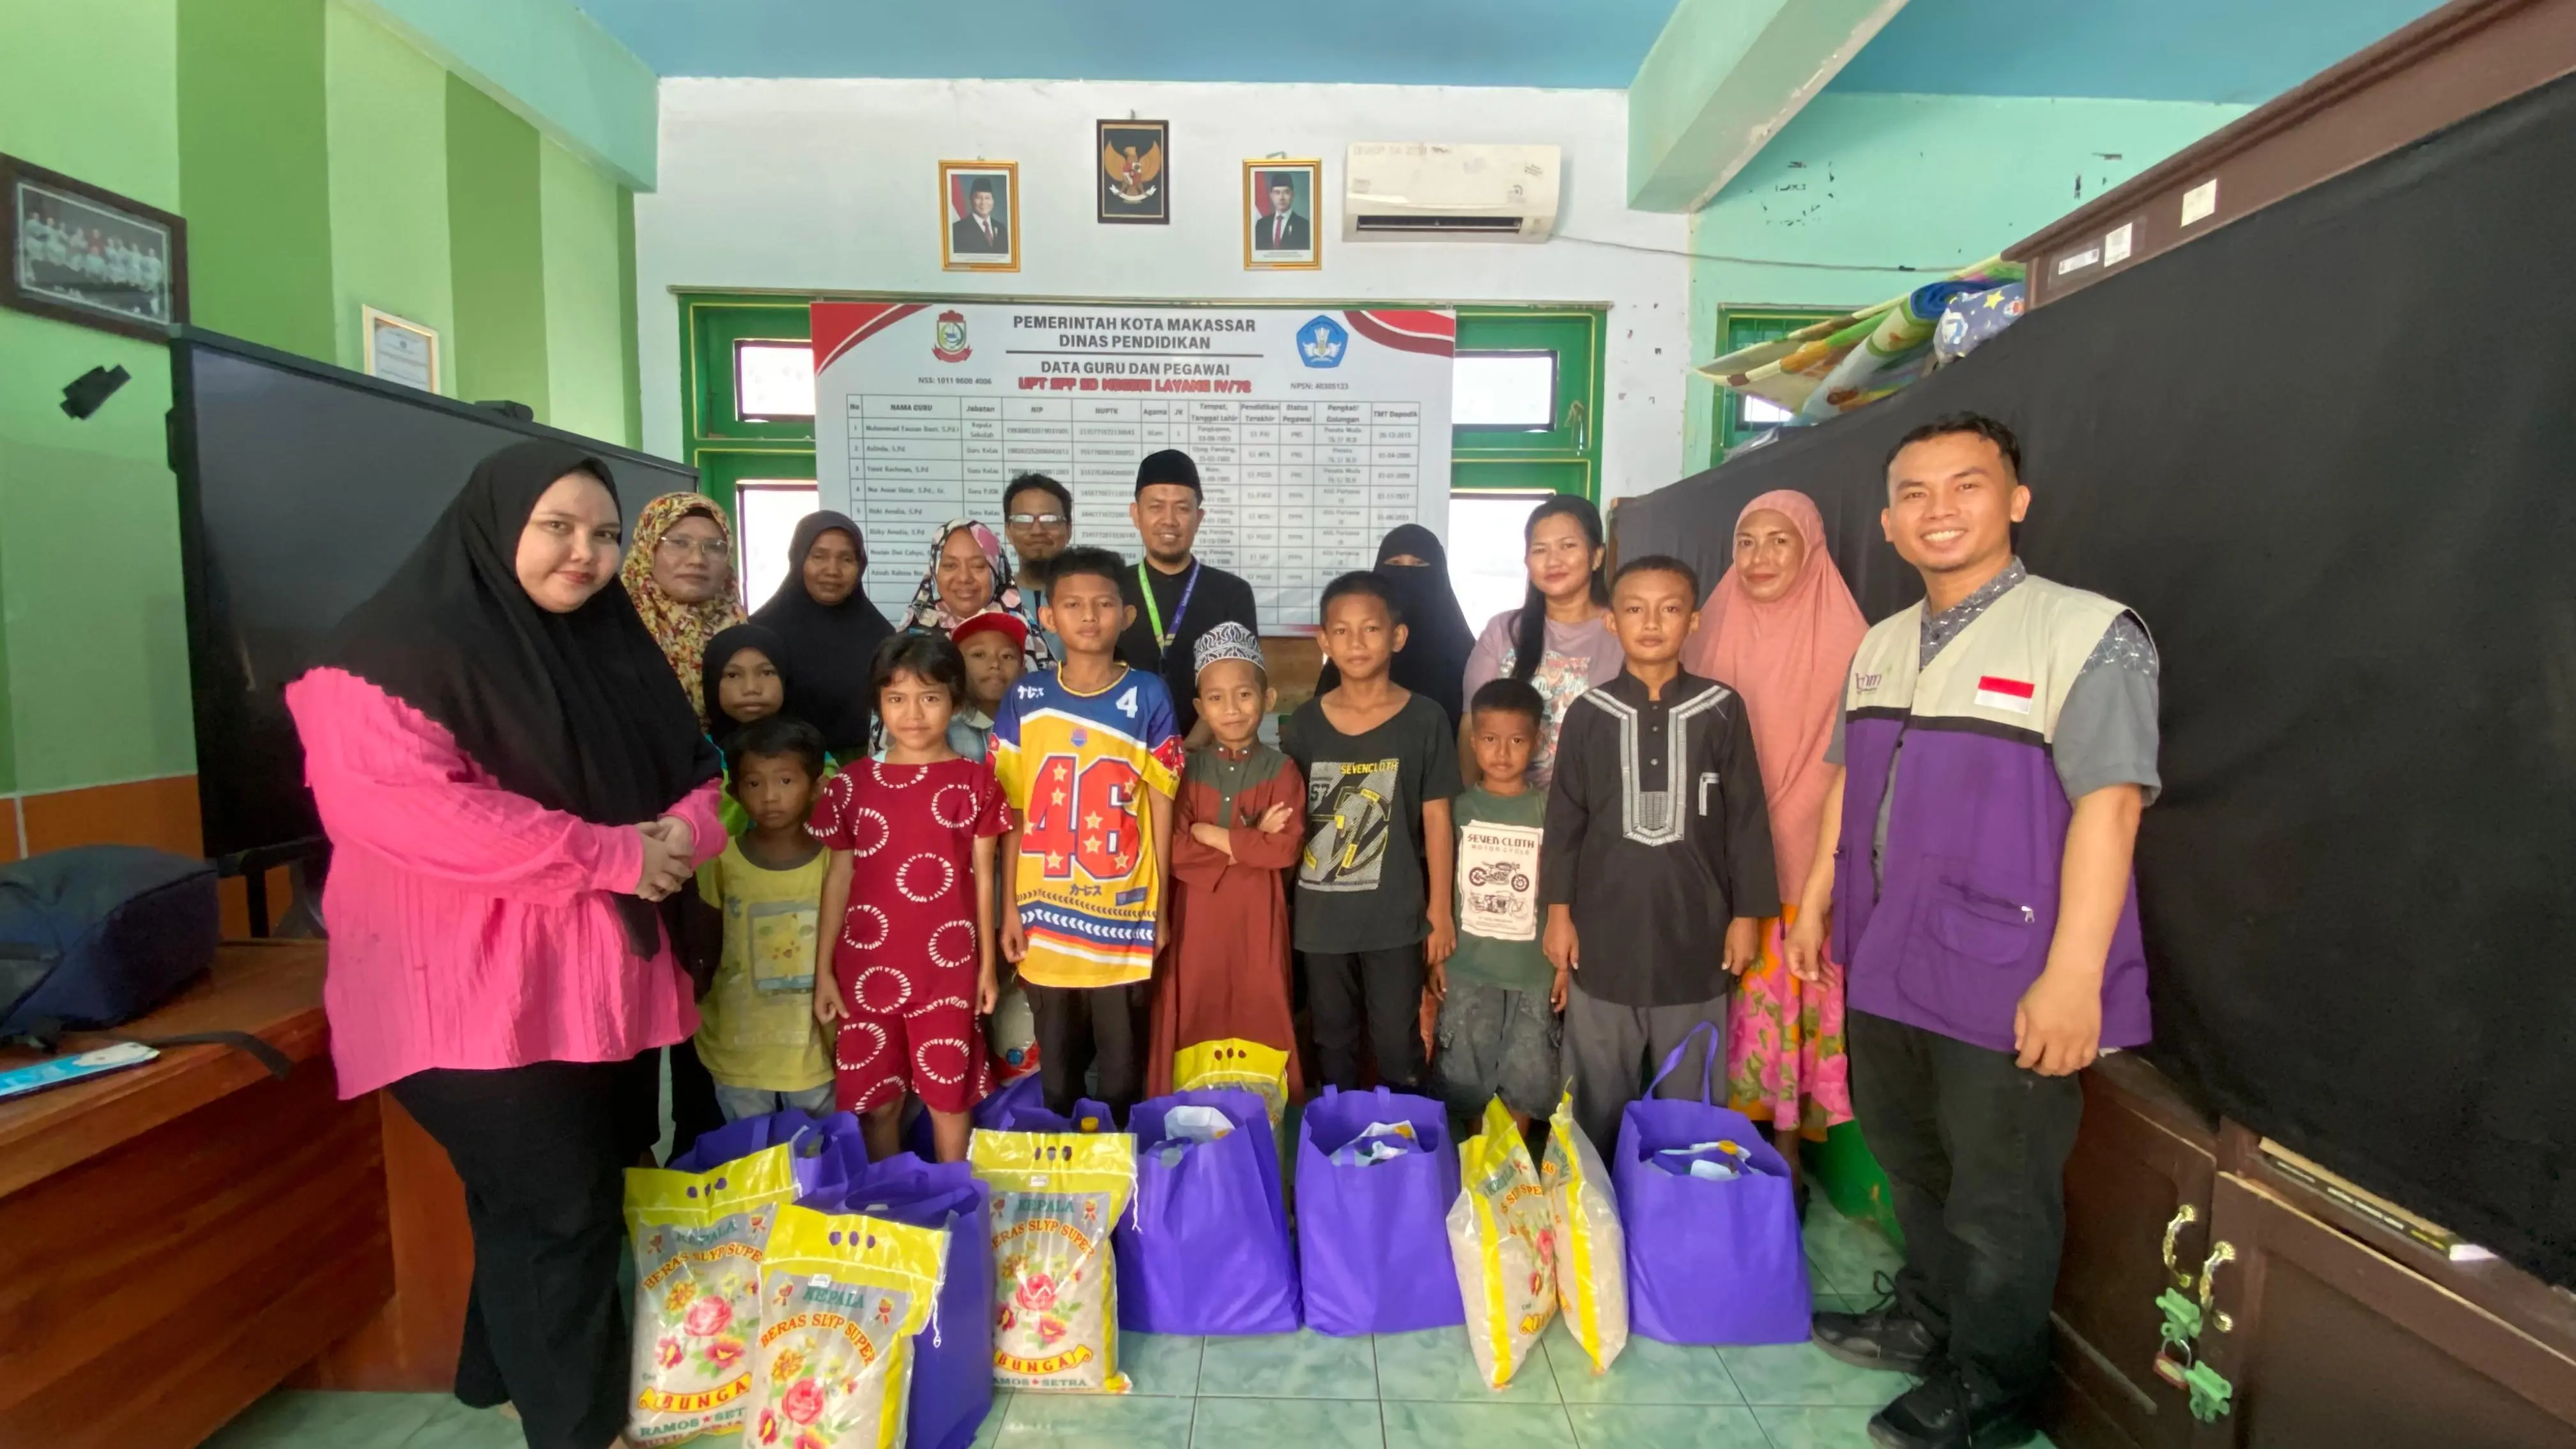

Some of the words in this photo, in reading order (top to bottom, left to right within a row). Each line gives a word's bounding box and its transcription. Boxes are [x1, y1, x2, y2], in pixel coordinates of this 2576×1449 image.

[1013, 316, 1117, 330] PEMERINTAH
[1121, 317, 1163, 331] KOTA
[1167, 318, 1255, 332] MAKASSAR
[1059, 334, 1108, 347] DINAS
[1112, 335, 1211, 349] PENDIDIKAN
[1041, 361, 1080, 373] DATA
[1084, 362, 1125, 374] GURU
[1129, 363, 1160, 374] DAN
[1163, 363, 1230, 375] PEGAWAI
[1018, 376, 1048, 390] UPT
[1115, 685, 1138, 719] 4
[1341, 760, 1399, 774] SEVENCLOTH
[1020, 753, 1141, 881] 46
[1467, 833, 1499, 845] SEVEN
[1501, 837, 1535, 848] CLOTH
[1016, 1199, 1075, 1213] KEPALA
[992, 1222, 1025, 1250] ERAS
[1028, 1218, 1059, 1233] SLYP
[1061, 1224, 1095, 1259] SUPER
[642, 1250, 690, 1290] BERAS
[725, 1242, 763, 1265] SUPE
[802, 1285, 865, 1309] KEPALA
[759, 1313, 808, 1349] BERAS
[811, 1313, 847, 1330] SLYP
[844, 1322, 878, 1367] SUPER
[998, 1352, 1069, 1373] BUNGA
[993, 1377, 1029, 1386] AMOS
[1042, 1378, 1087, 1386] SETRA
[663, 1380, 747, 1410] BUNGA
[640, 1418, 700, 1438] RAMOS
[714, 1407, 748, 1422] SET
